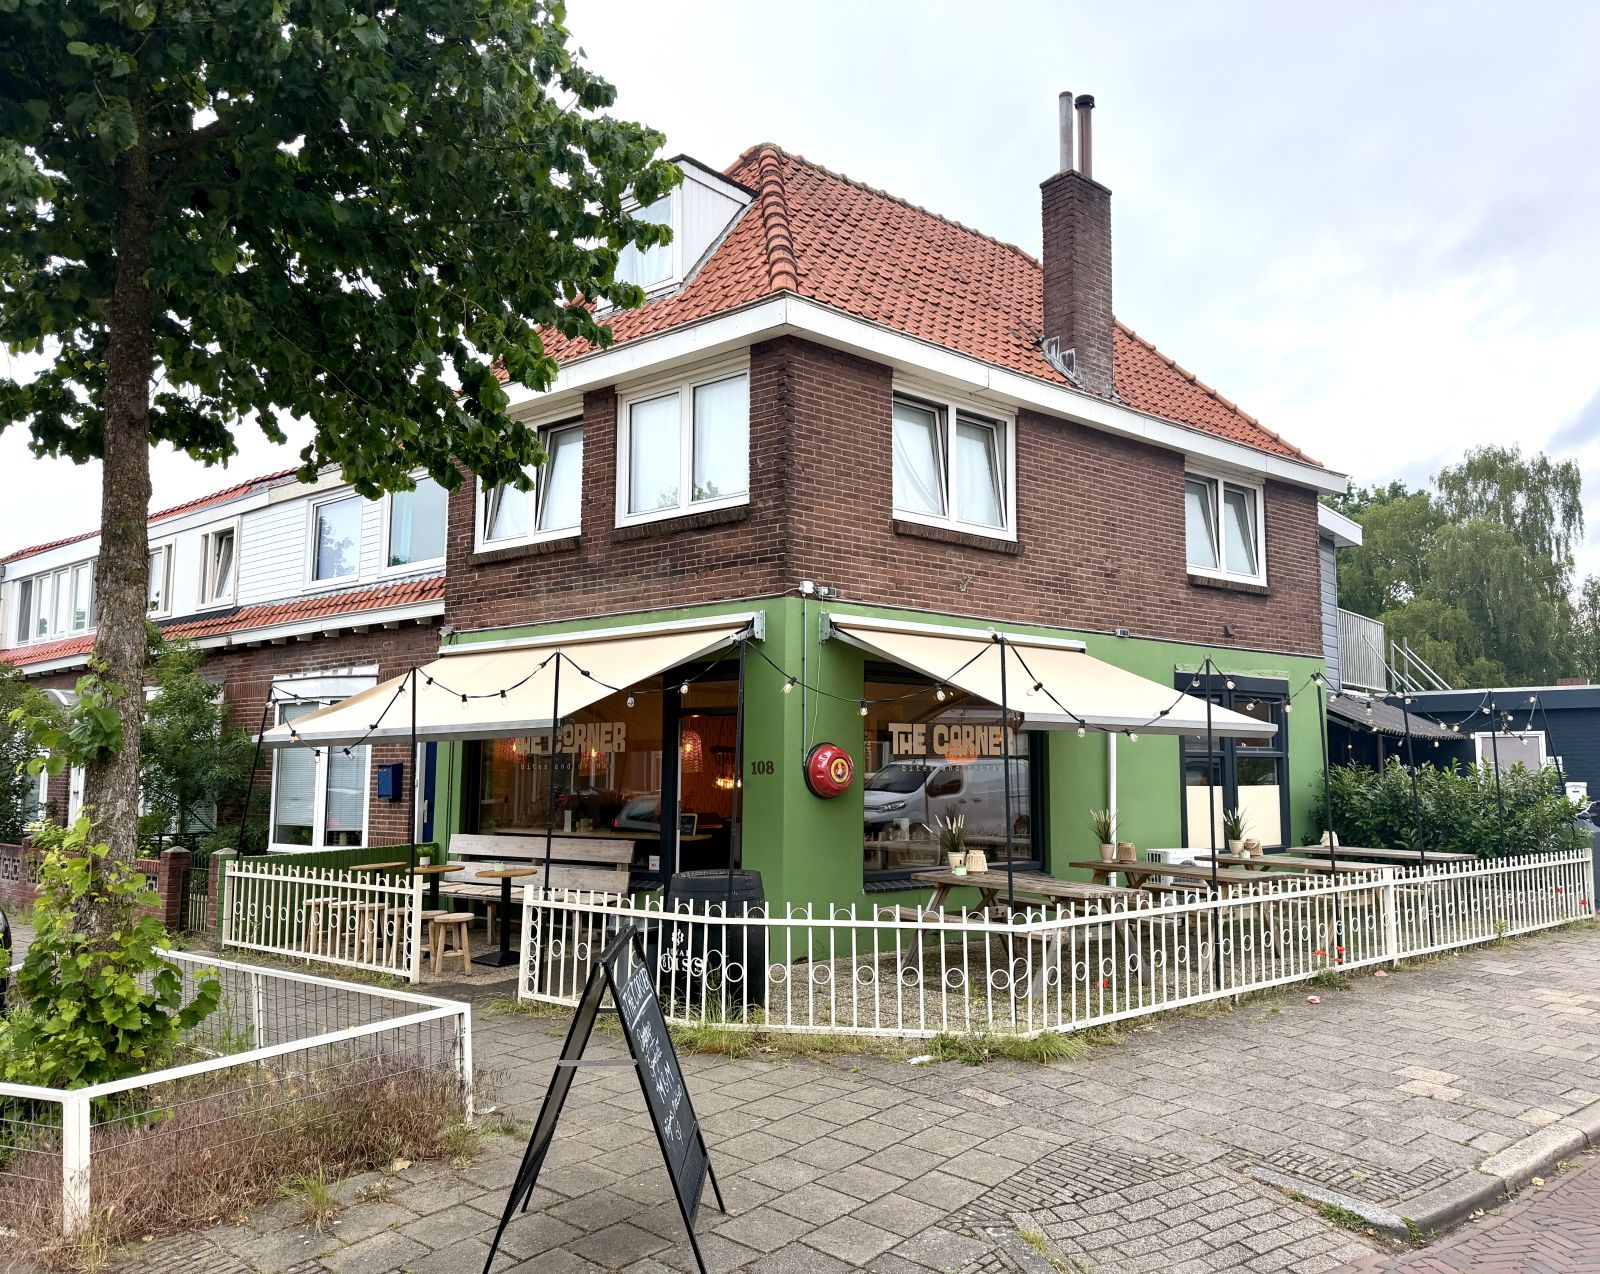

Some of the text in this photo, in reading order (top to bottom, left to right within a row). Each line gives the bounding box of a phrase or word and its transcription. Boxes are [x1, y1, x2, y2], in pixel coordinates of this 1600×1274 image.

[888, 722, 1016, 756] THE CORNER
[554, 762, 571, 770] and
[577, 762, 613, 770] drnk
[751, 760, 775, 775] 108
[902, 764, 933, 772] bites
[942, 764, 960, 772] and
